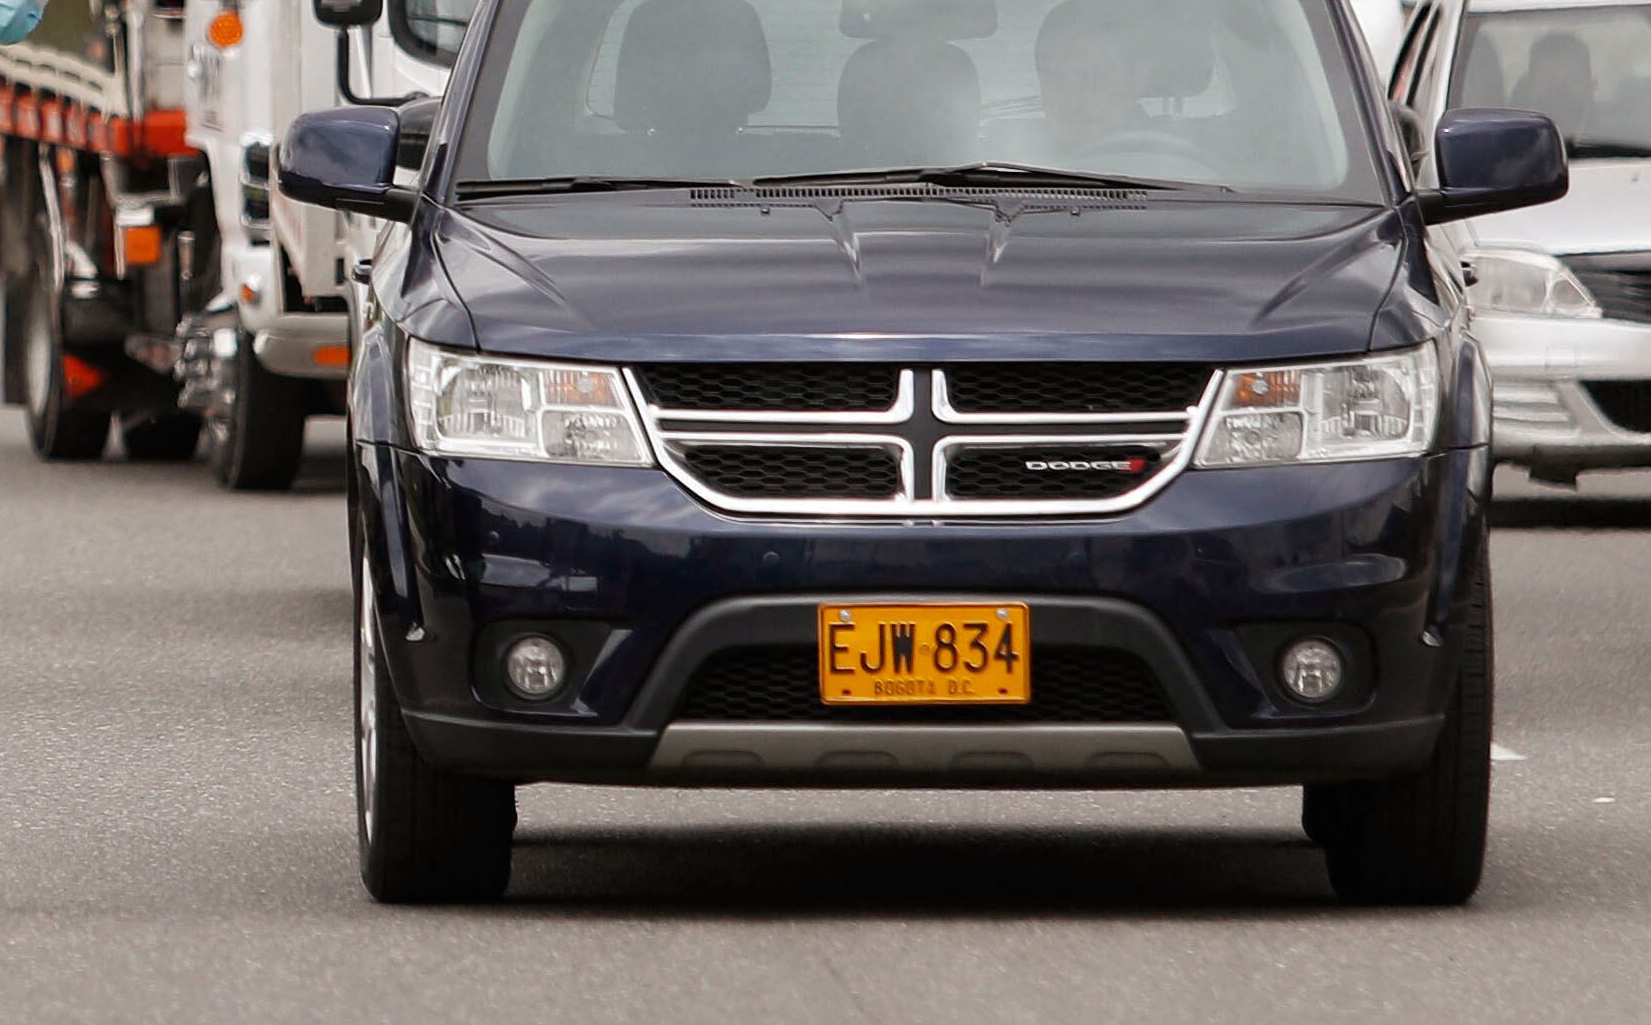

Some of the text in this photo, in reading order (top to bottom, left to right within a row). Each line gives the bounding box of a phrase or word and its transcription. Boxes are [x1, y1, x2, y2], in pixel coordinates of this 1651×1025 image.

[1025, 460, 1132, 471] DODGE
[829, 622, 1019, 675] EJW 834
[874, 678, 935, 696] BOGOTA
